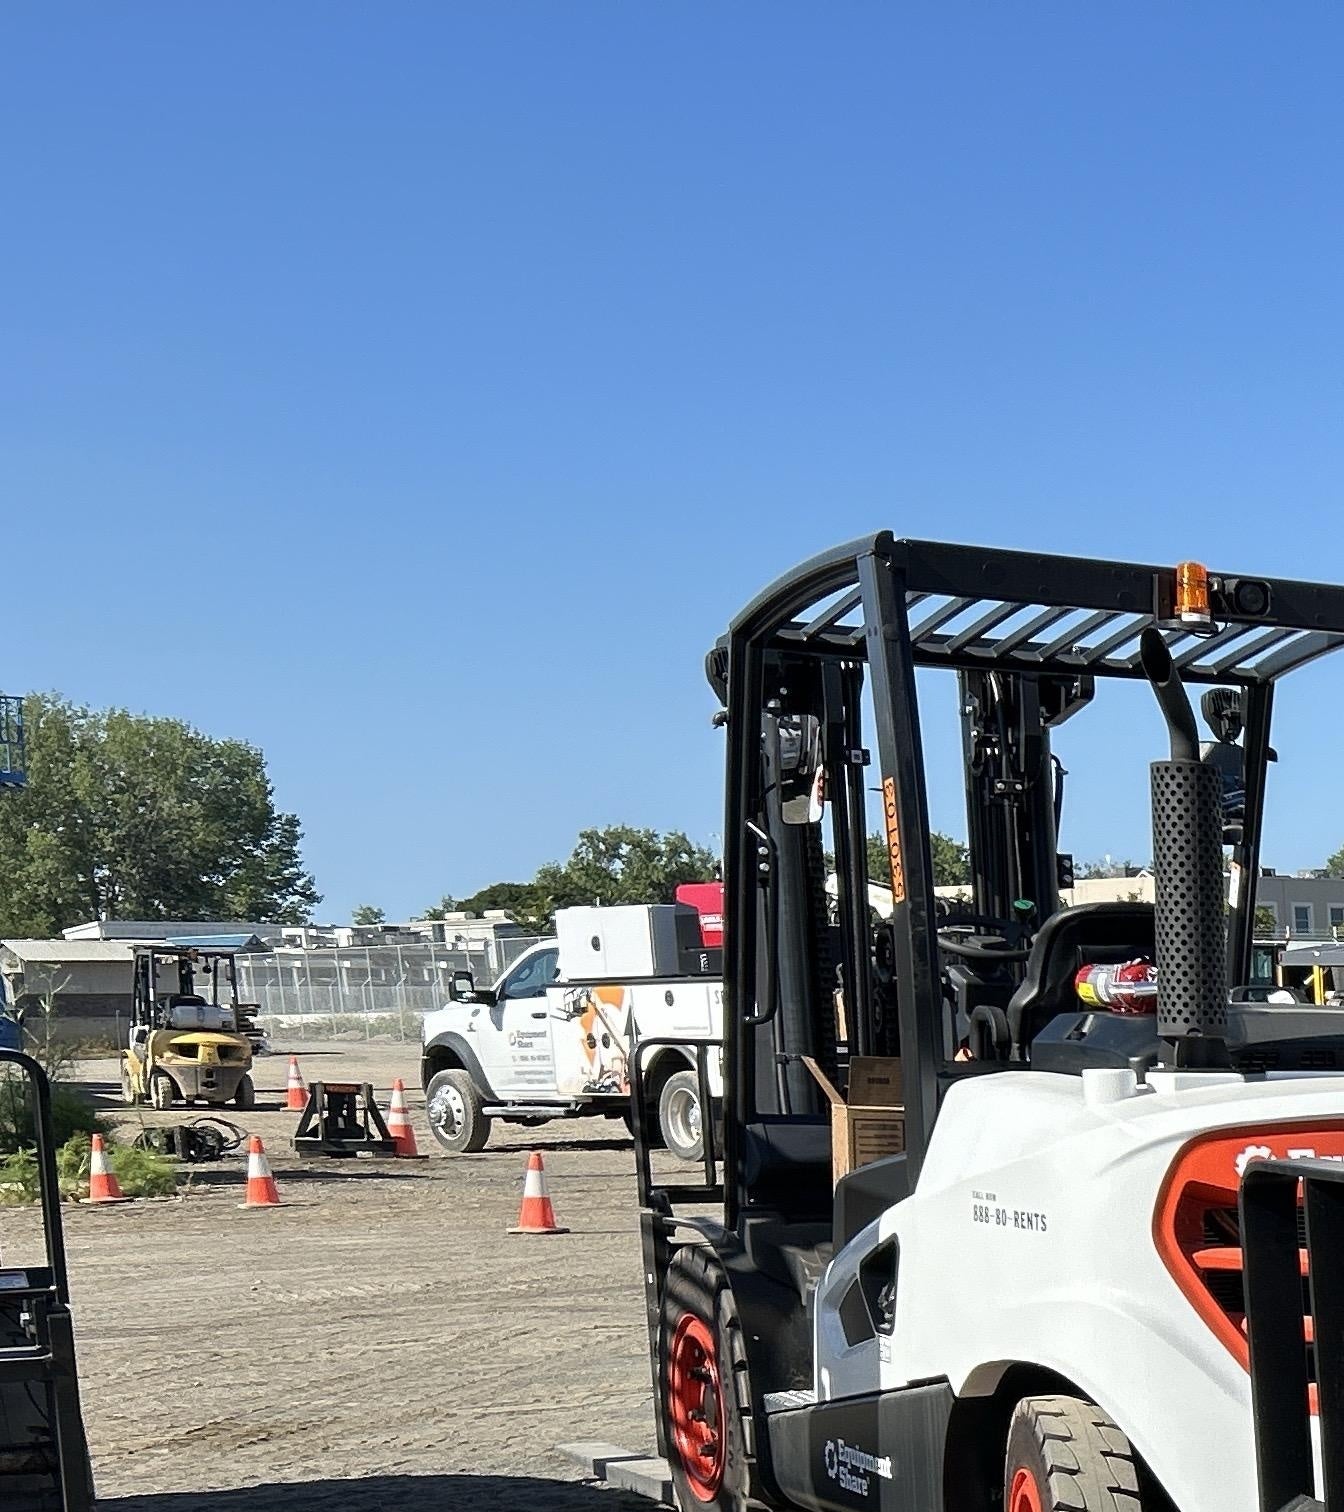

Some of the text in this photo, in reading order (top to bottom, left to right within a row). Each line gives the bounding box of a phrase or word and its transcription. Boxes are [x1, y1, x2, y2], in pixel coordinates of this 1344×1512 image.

[973, 1204, 1047, 1232] 888-80-RENTS
[837, 1438, 892, 1479] Equipment
[839, 1465, 869, 1497] Share
